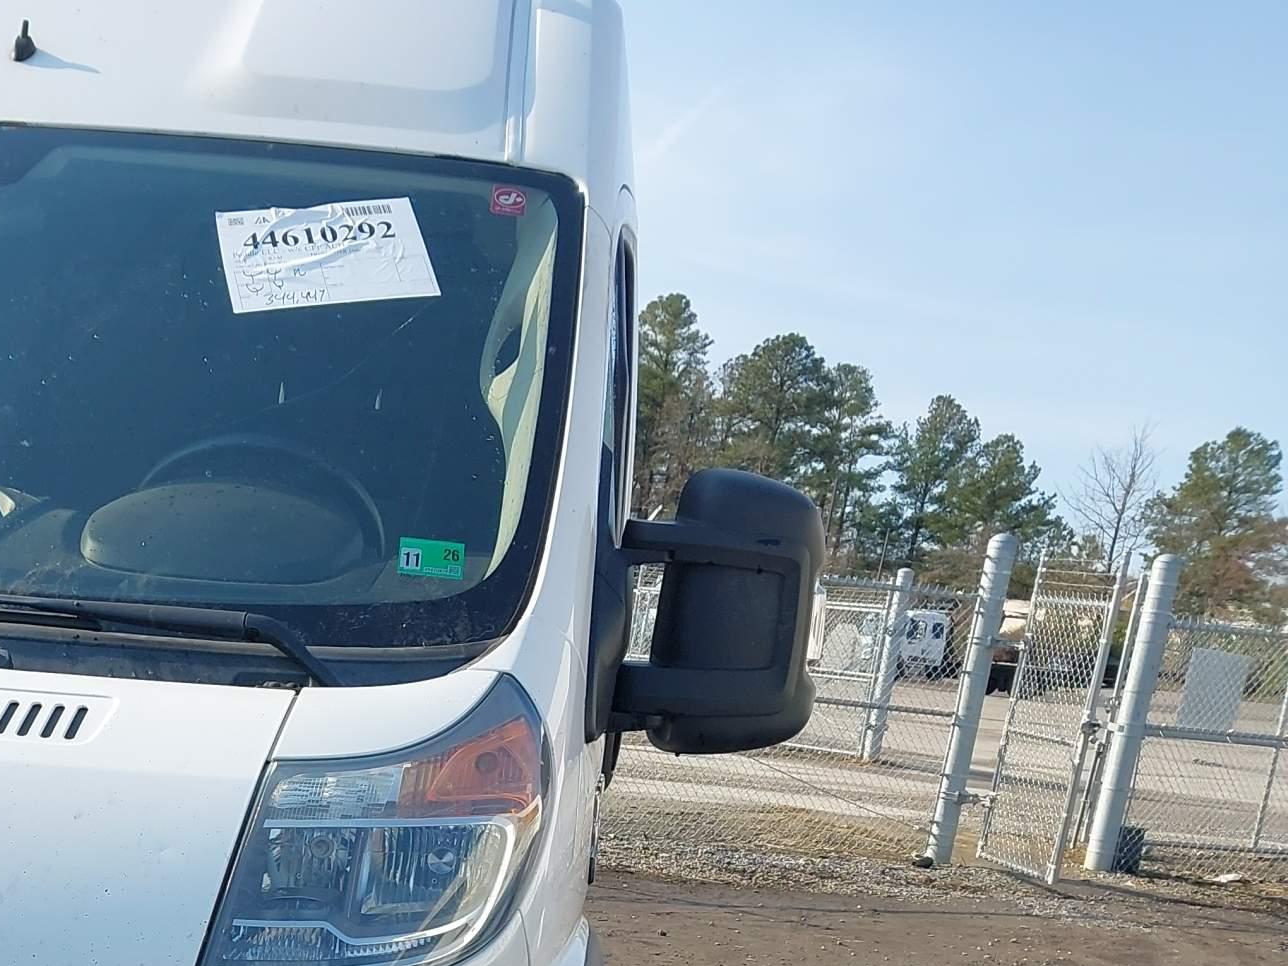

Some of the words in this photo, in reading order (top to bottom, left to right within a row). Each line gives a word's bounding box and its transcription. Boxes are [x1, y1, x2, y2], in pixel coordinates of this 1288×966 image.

[242, 220, 396, 250] 44610292
[403, 551, 421, 568] 11
[443, 549, 460, 562] 26
